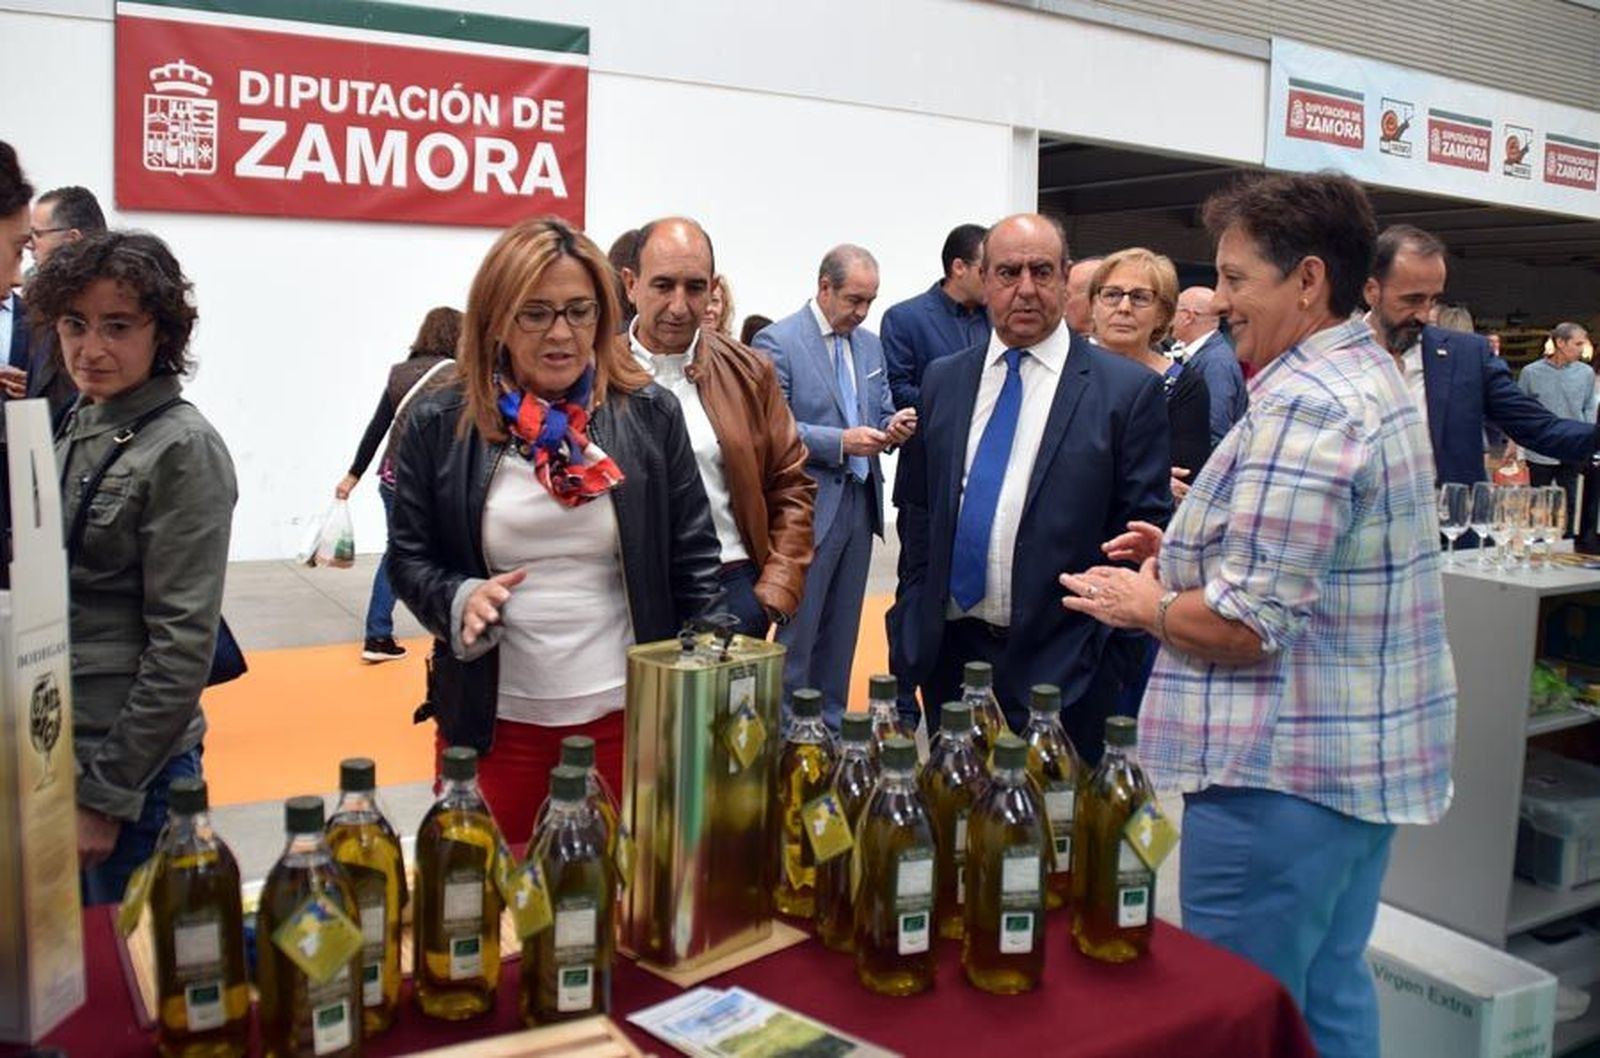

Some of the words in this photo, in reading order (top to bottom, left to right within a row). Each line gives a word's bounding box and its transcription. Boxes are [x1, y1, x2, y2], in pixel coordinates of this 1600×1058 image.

[237, 69, 500, 128] DIPUTACIÓN
[512, 96, 566, 132] DE
[1305, 114, 1362, 140] ZAMORA
[234, 116, 568, 198] ZAMORA
[1441, 142, 1488, 164] ZAMORA
[1556, 163, 1596, 183] ZAMORA
[1373, 963, 1424, 996] Virgen
[1428, 986, 1474, 1019] Extra
